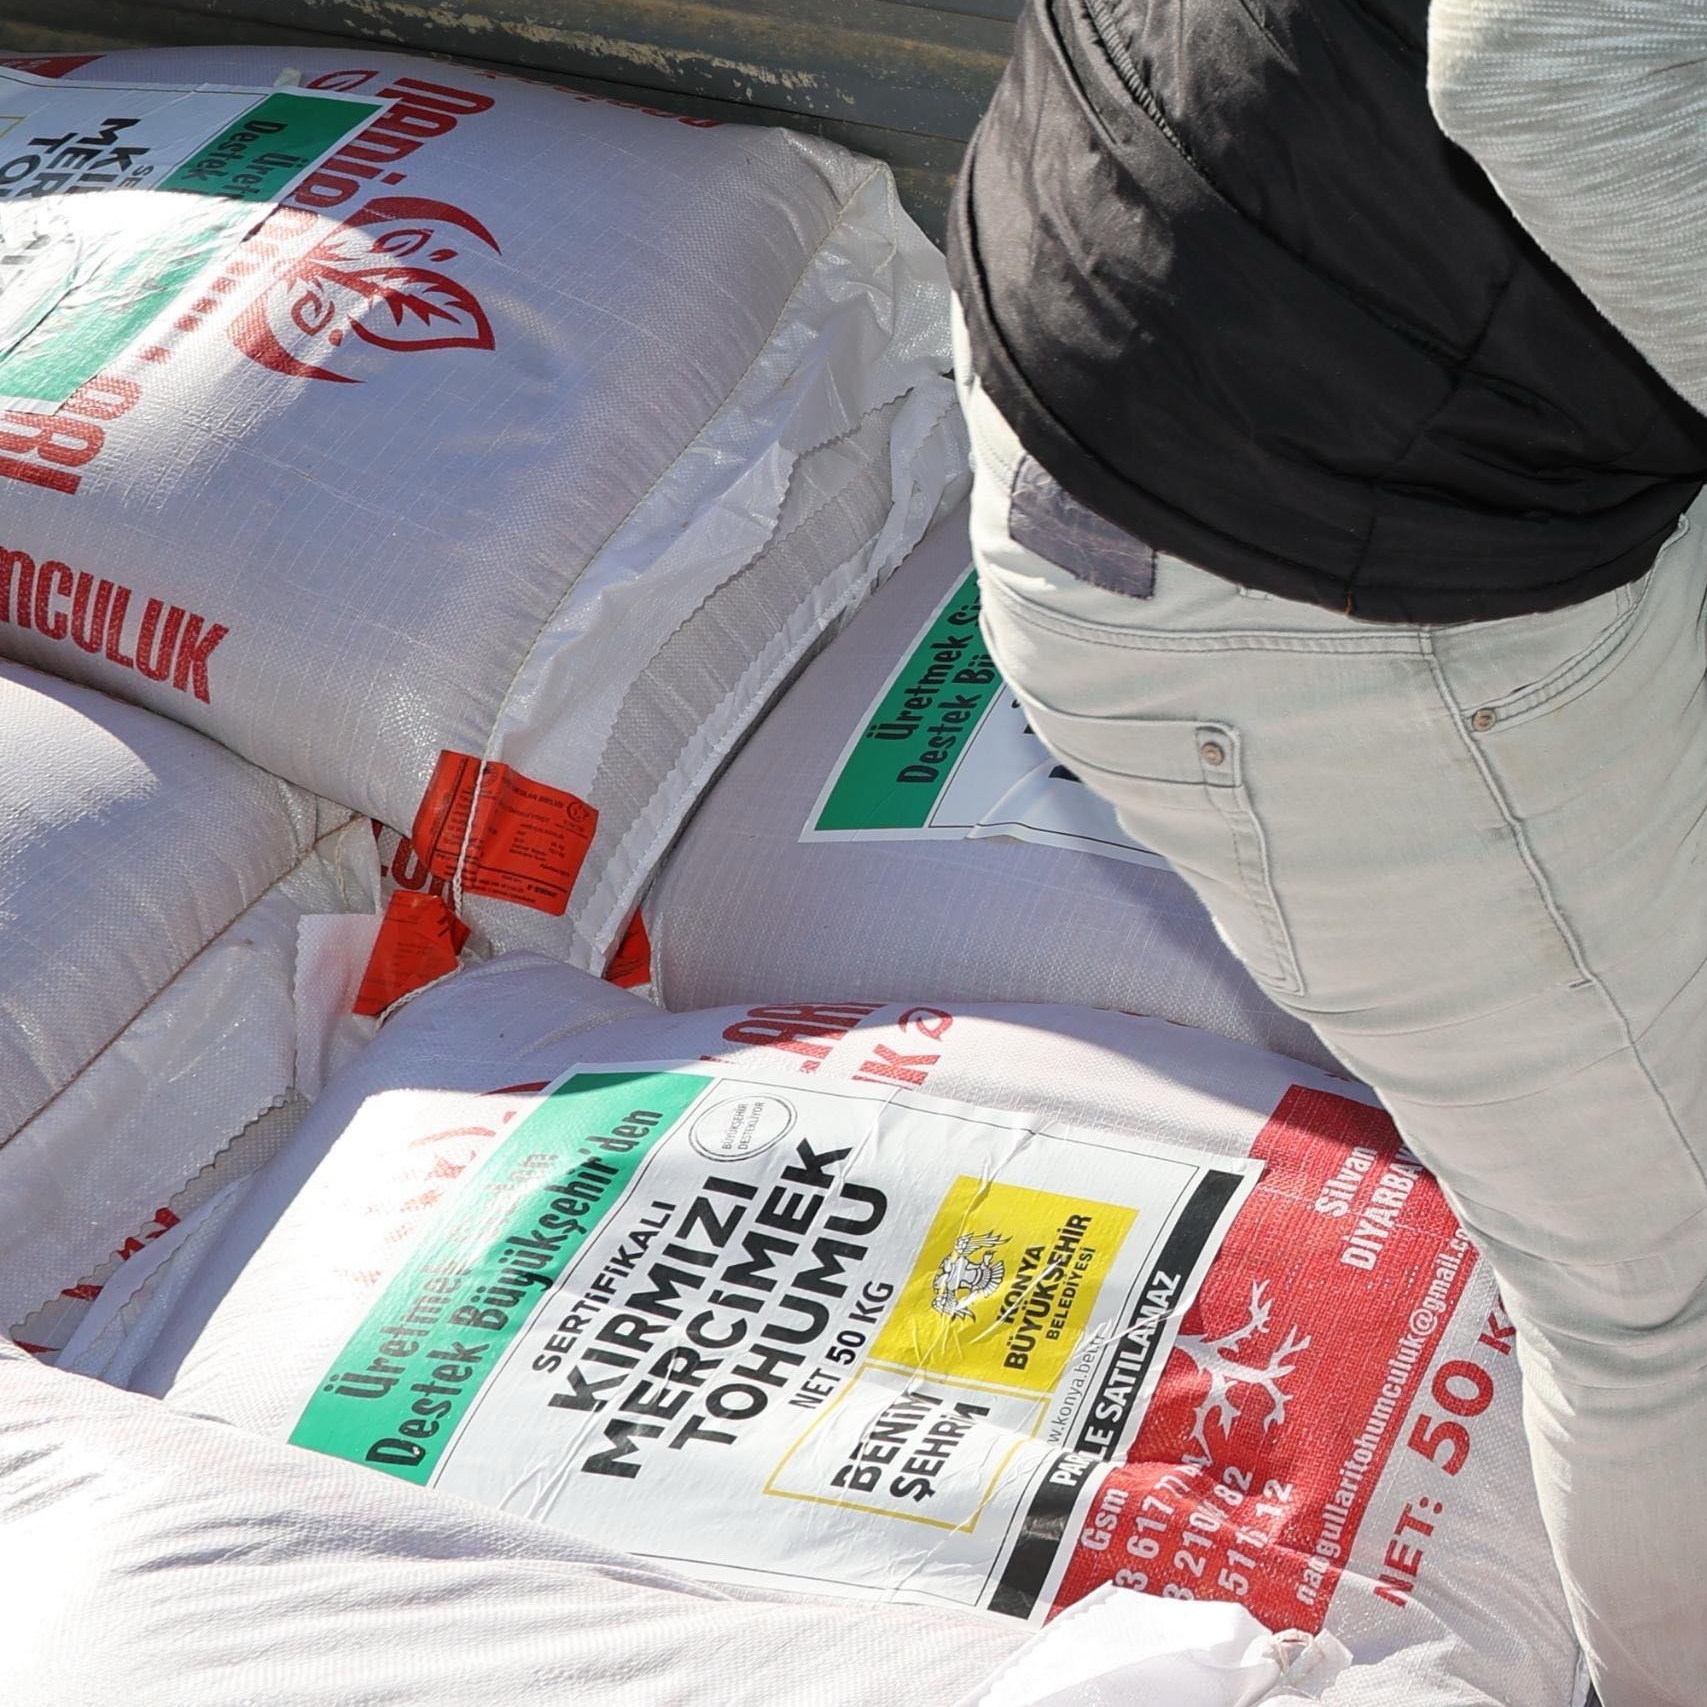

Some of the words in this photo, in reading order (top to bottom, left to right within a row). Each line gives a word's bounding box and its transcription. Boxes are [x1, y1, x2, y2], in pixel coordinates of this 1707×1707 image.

[180, 118, 289, 183] Destek
[866, 634, 974, 740] Üretmek
[896, 694, 982, 783] Destek
[1314, 1144, 1380, 1221] Silvan
[365, 1339, 491, 1467] Destek
[447, 1108, 664, 1333] Büyükşehir'den
[532, 1199, 677, 1373] SERTİFİKALI
[547, 1175, 759, 1413] KIRMIZI
[580, 1137, 854, 1479] MERCİMEK
[668, 1182, 888, 1450] TOHUMU
[995, 1243, 1047, 1327] KONYA
[1003, 1212, 1093, 1371] BÜYÜKŞEHİR
[1045, 1246, 1098, 1341] BELEDİYESİ
[788, 1370, 843, 1411] NET
[826, 1329, 866, 1367] 50
[848, 1280, 895, 1325] KG
[1100, 1269, 1183, 1425] SATILAMAZ
[830, 1391, 944, 1493] BENİM
[1407, 1359, 1494, 1477] 50
[1080, 1487, 1130, 1553] Gsm
[1126, 1494, 1175, 1560] 617
[1212, 1465, 1255, 1507] 82
[1253, 1479, 1295, 1525] 12
